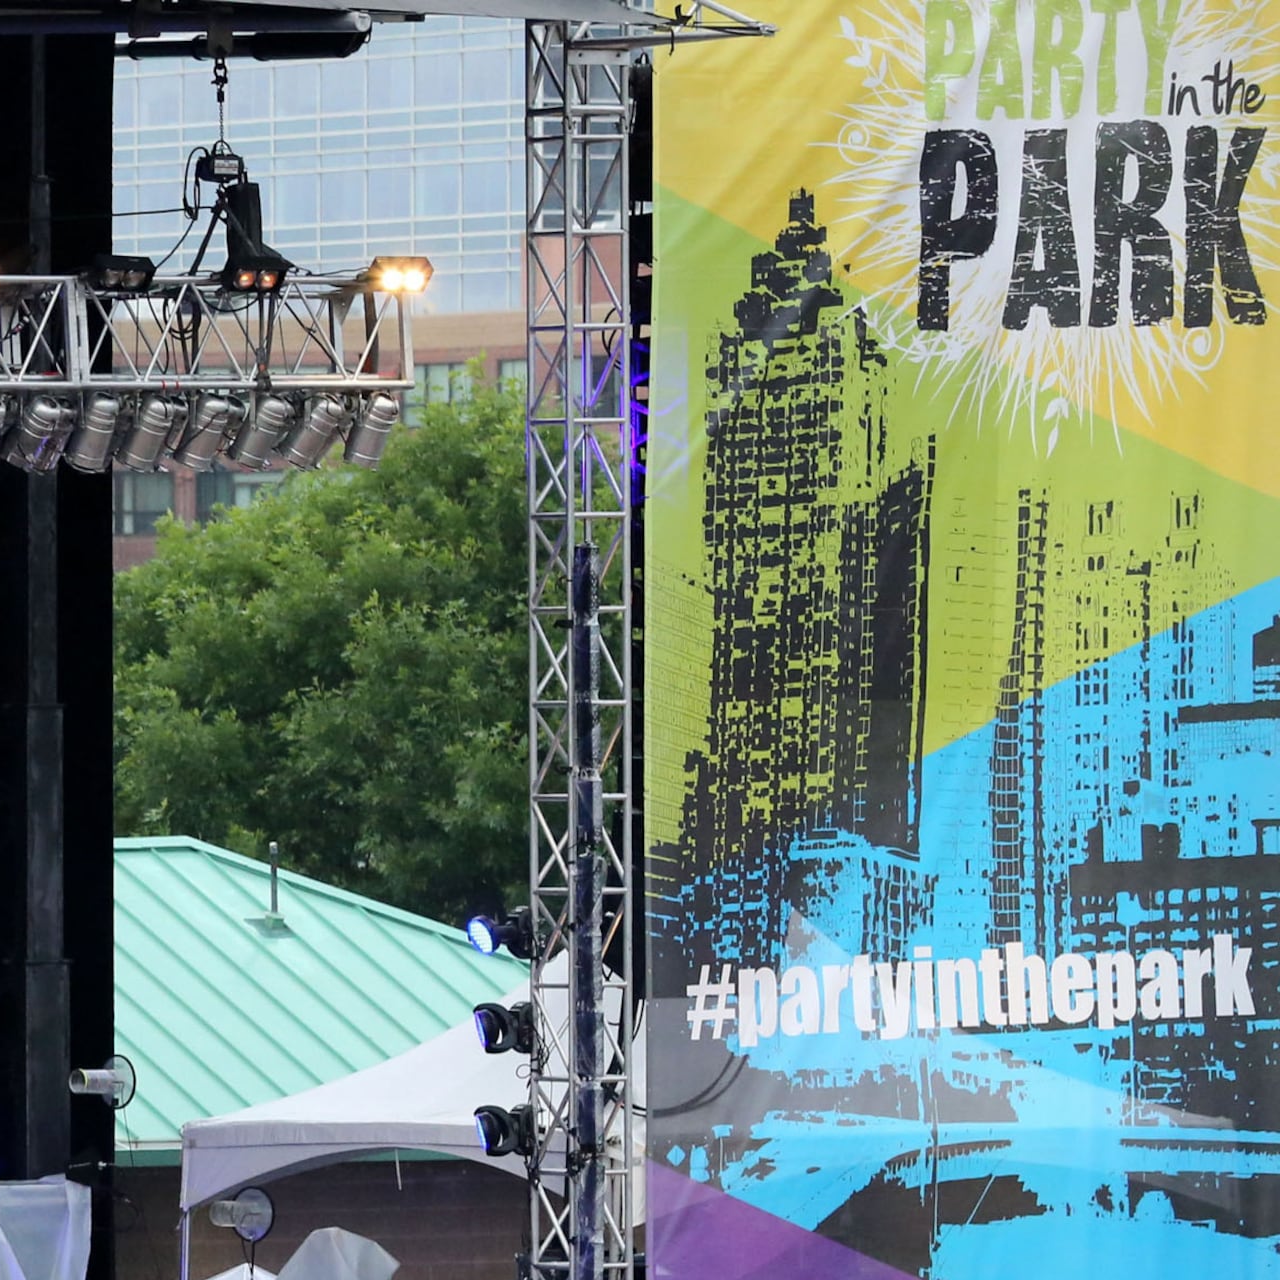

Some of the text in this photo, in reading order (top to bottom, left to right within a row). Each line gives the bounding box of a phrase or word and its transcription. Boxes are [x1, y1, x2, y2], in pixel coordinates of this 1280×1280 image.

[924, 0, 1266, 121] PARTY in the
[916, 119, 1268, 332] PARK
[686, 933, 1256, 1048] #partyinthepark
